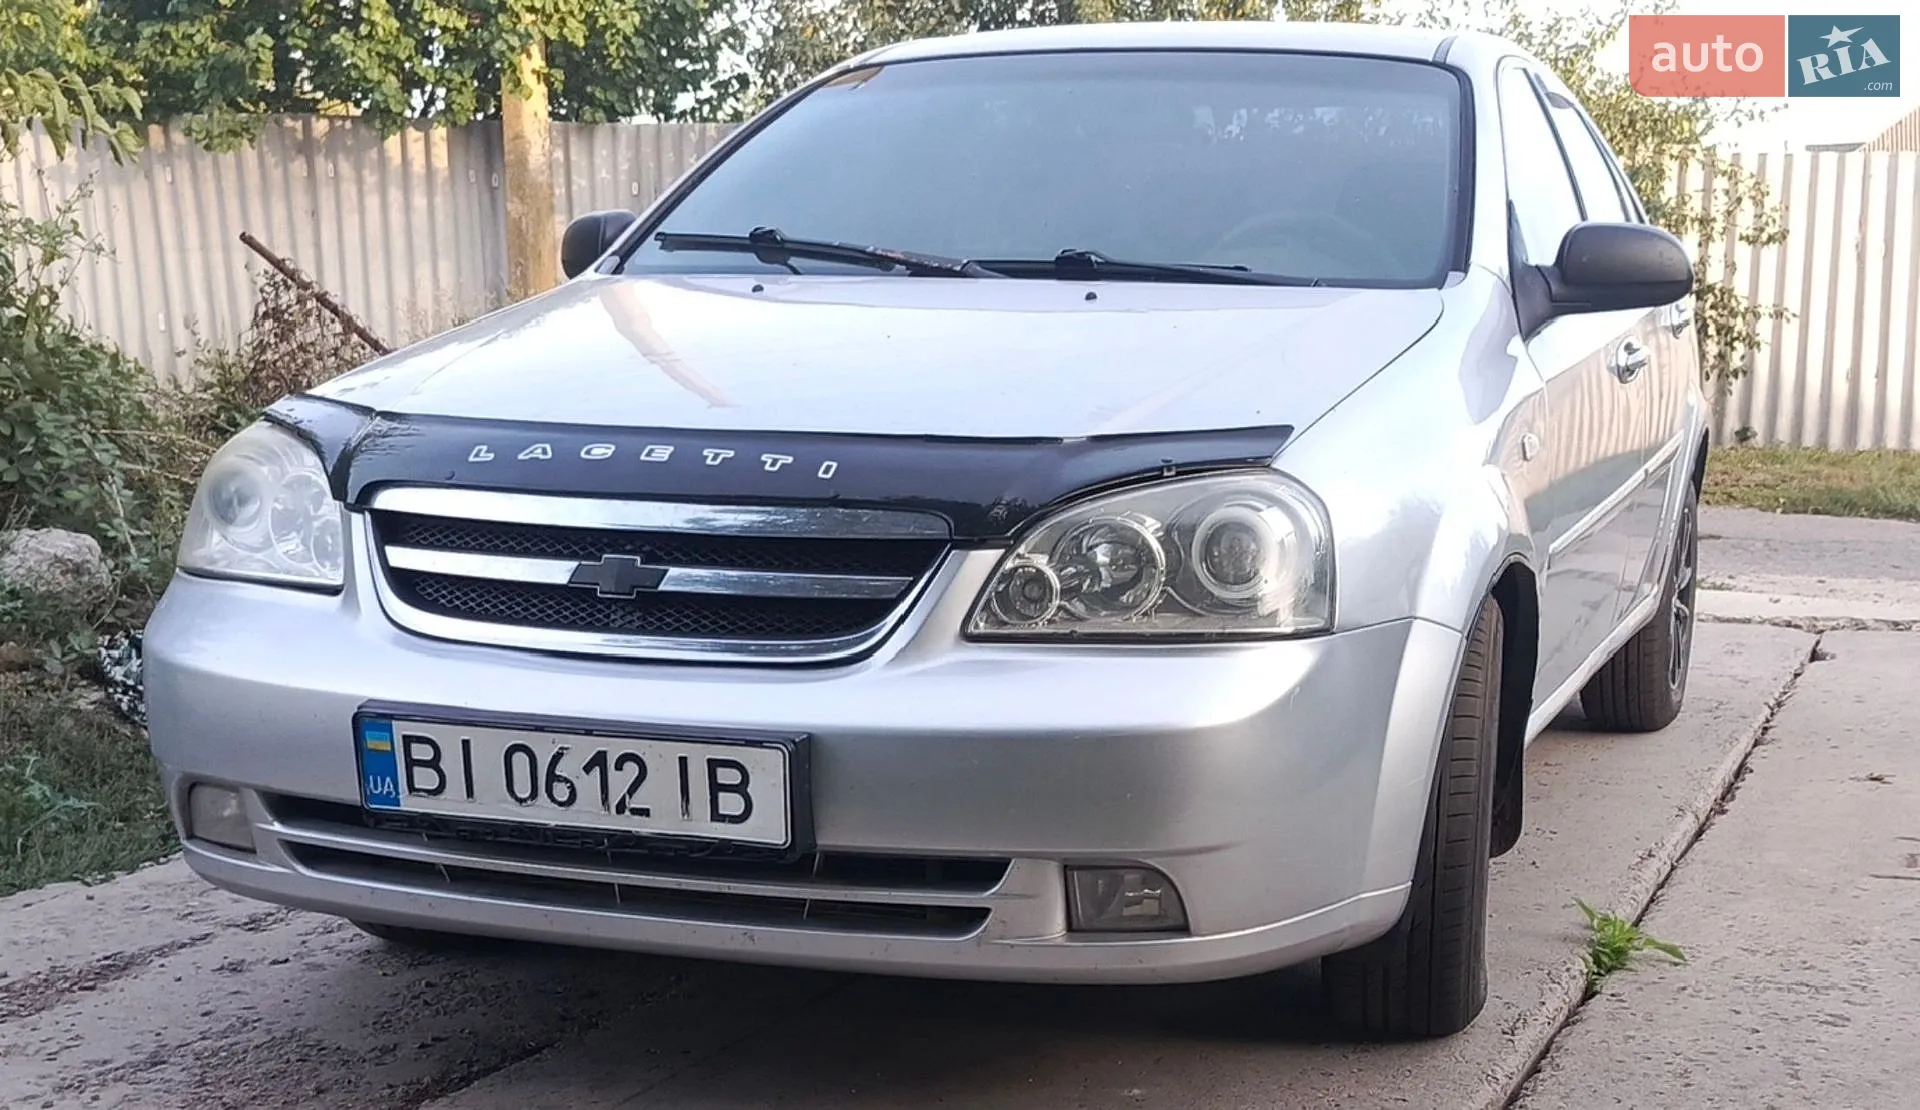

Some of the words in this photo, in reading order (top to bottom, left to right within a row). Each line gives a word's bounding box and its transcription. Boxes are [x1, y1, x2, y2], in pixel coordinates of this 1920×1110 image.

[468, 443, 838, 479] LACETTI
[369, 774, 396, 798] UA
[401, 733, 476, 800] BI
[503, 742, 652, 818] 0612
[678, 754, 754, 825] IB
